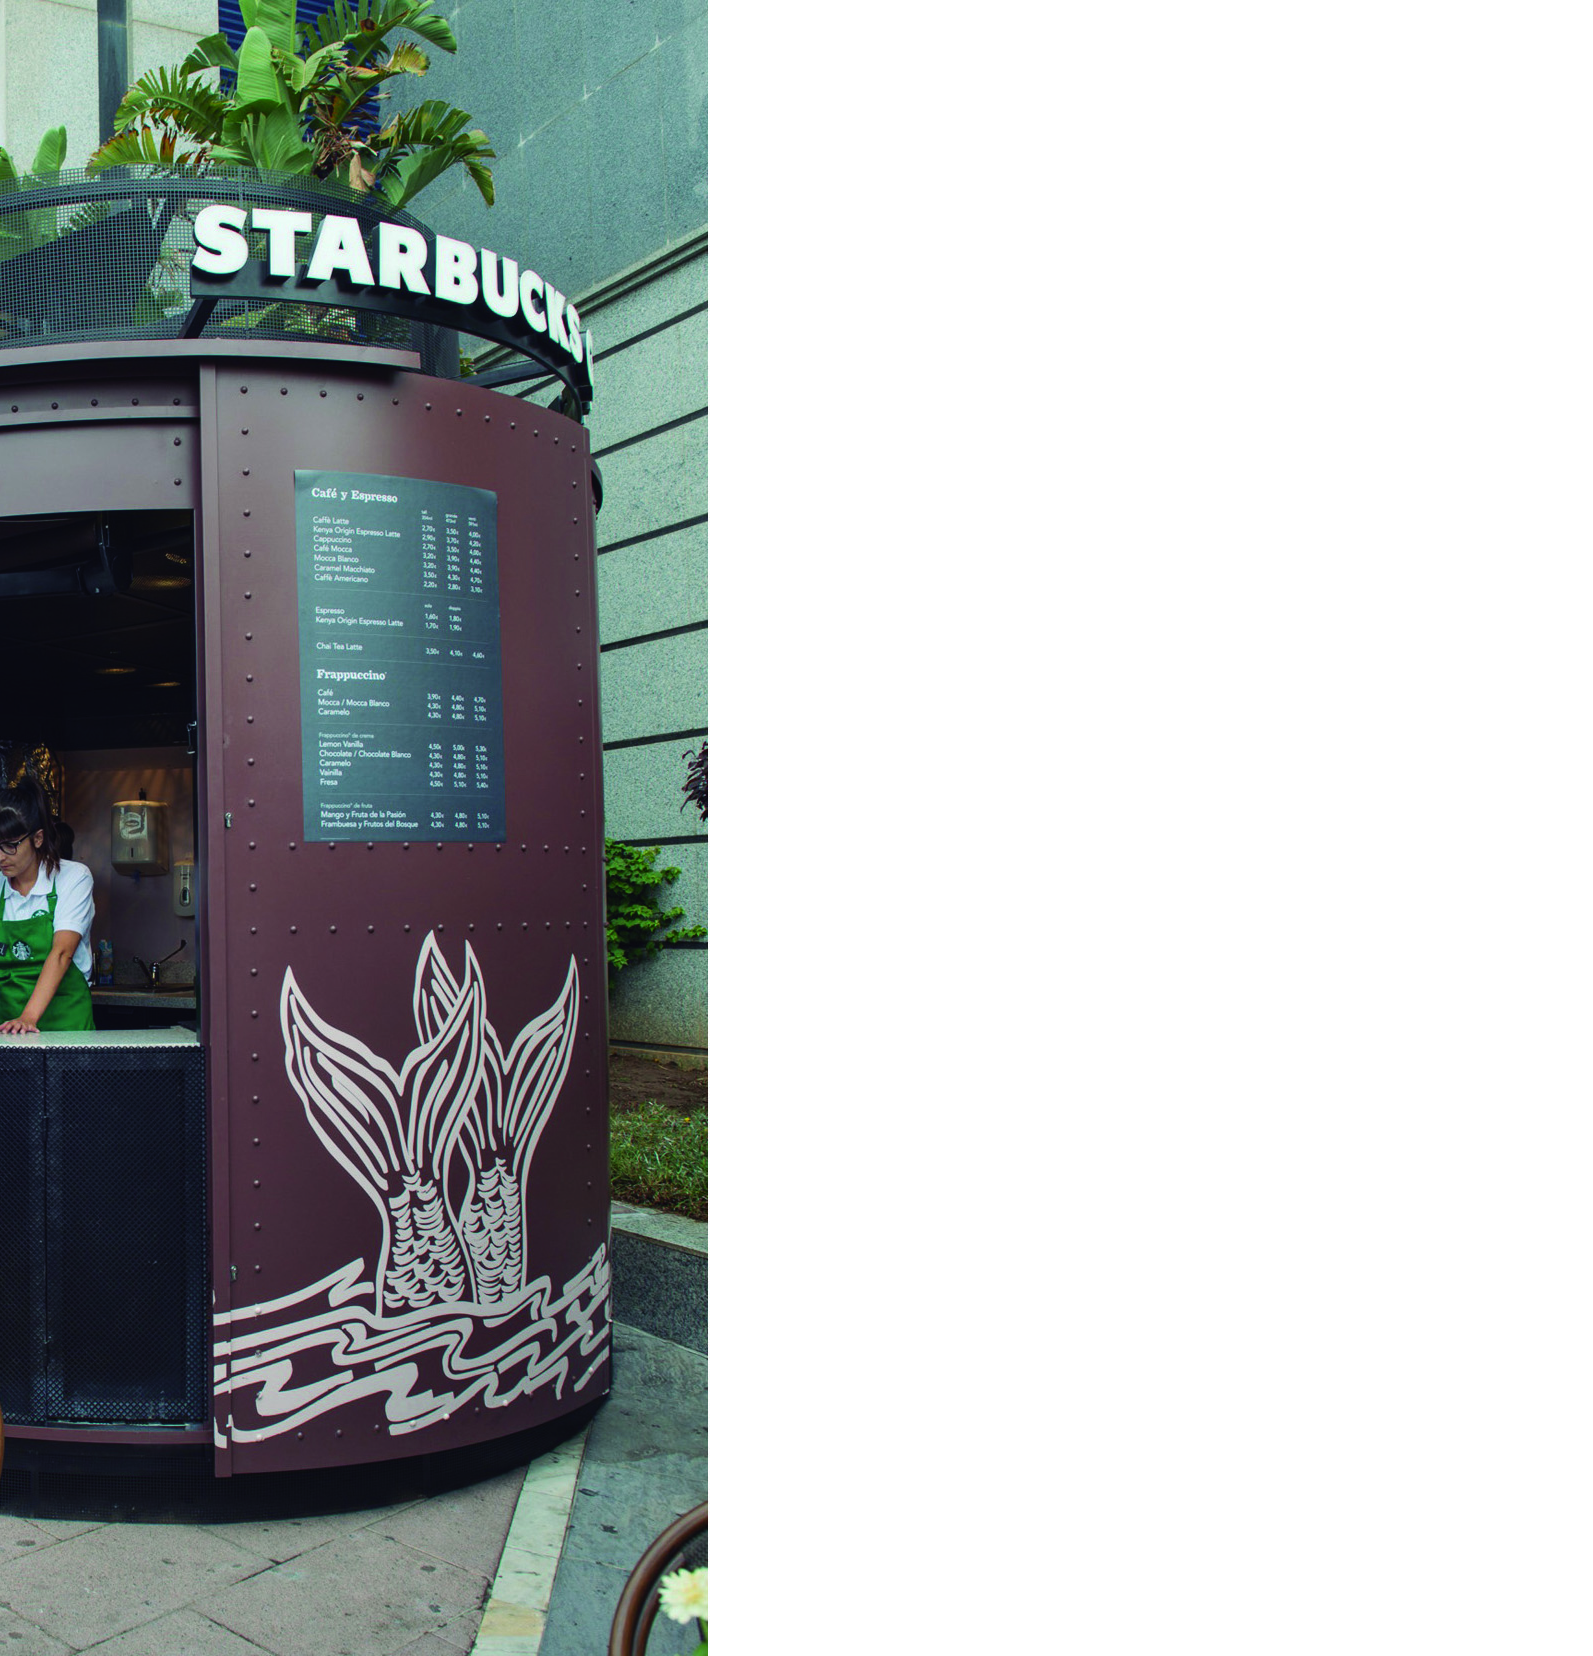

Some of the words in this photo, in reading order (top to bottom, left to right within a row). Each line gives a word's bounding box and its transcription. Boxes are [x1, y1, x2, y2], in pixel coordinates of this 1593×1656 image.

[191, 204, 584, 364] STARBUCKS
[311, 487, 337, 499] Café
[340, 491, 348, 501] y
[351, 490, 398, 503] Espresso
[312, 516, 331, 524] Caffè
[313, 526, 333, 534] Kenya
[334, 527, 355, 536] Origin
[356, 528, 384, 536] Espresso
[313, 535, 352, 543] Cappuccino
[338, 555, 359, 563] Blanco
[343, 565, 375, 573] Macchiato
[334, 575, 368, 583] Americano
[316, 606, 345, 614] Espresso
[316, 617, 335, 625] Kenya
[337, 617, 357, 626] Origin
[359, 618, 386, 626] Espresso
[388, 619, 403, 627] Latte
[316, 642, 331, 650] Chai
[333, 642, 344, 650] Tea
[346, 643, 363, 651] Latte
[318, 708, 350, 716] Caramelo
[358, 750, 390, 758] Chocolate
[321, 811, 345, 820] Mango
[396, 821, 418, 829] Bosque
